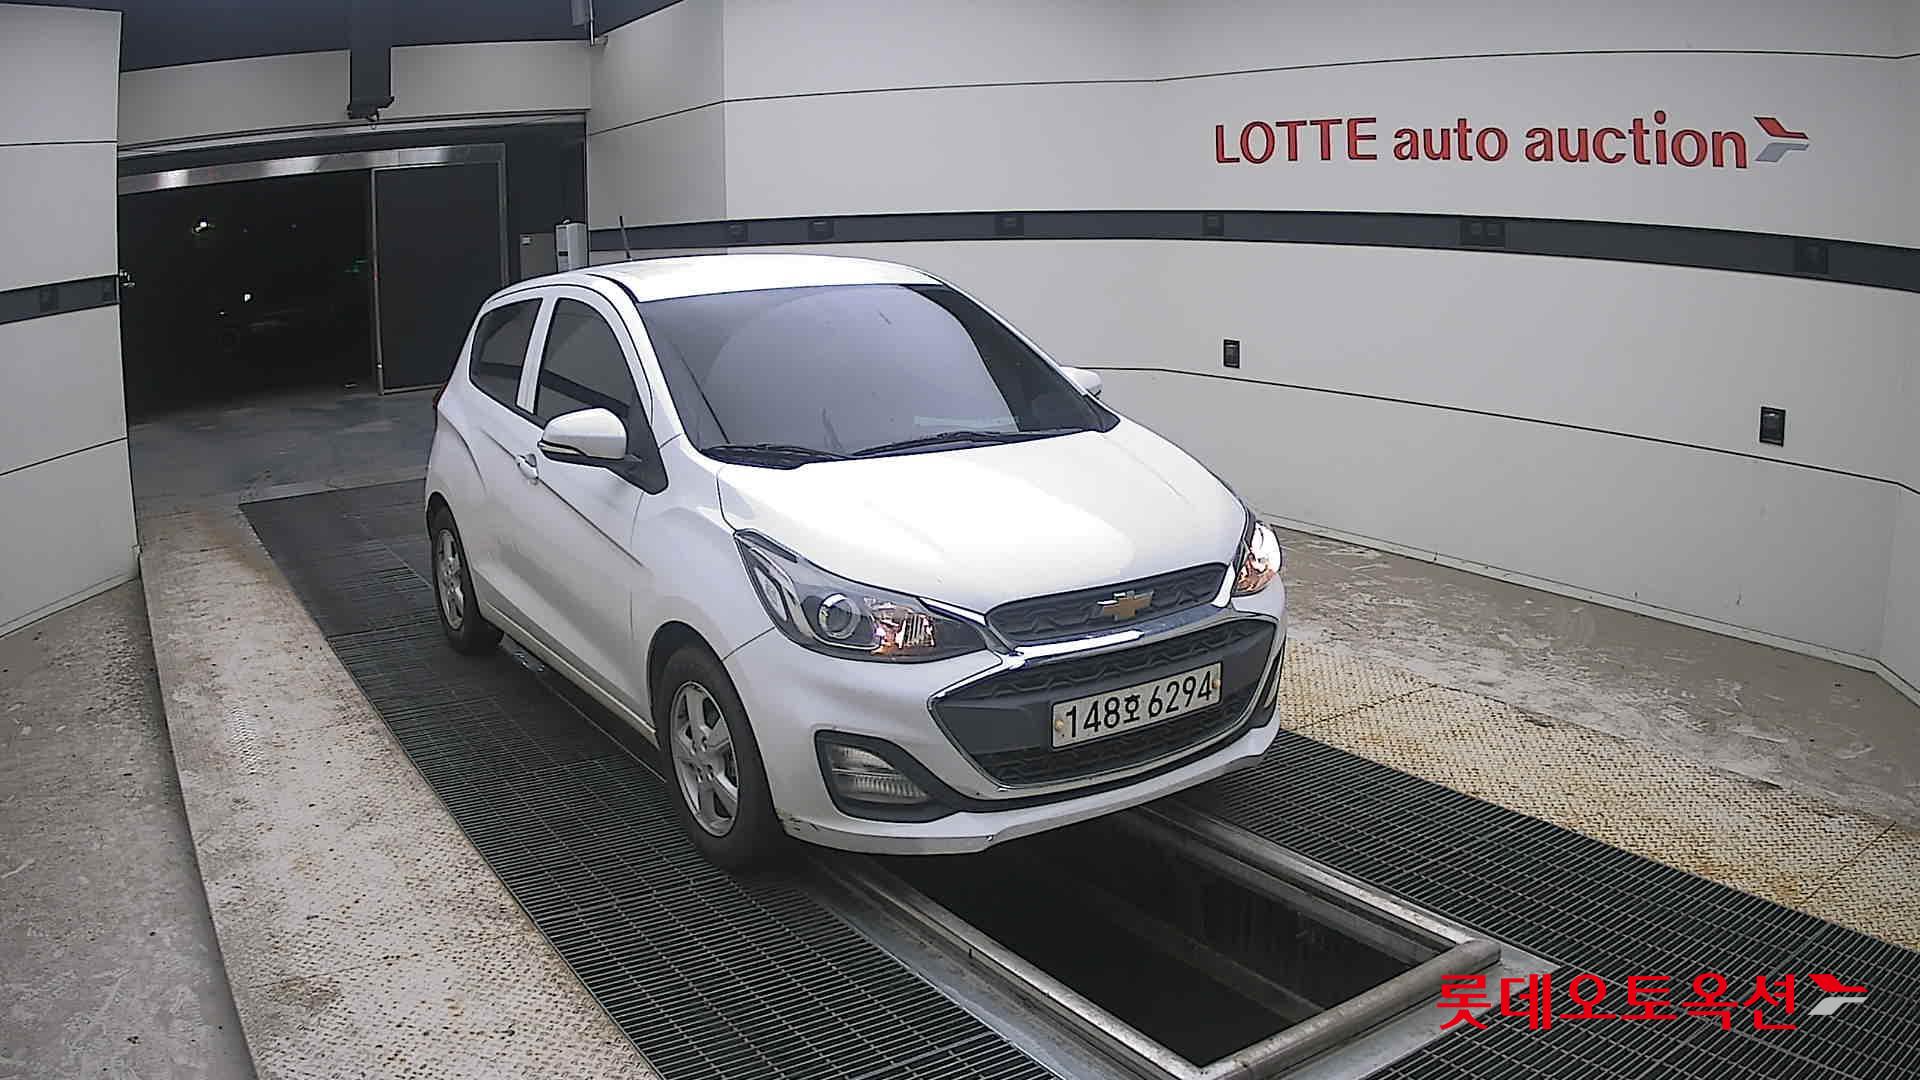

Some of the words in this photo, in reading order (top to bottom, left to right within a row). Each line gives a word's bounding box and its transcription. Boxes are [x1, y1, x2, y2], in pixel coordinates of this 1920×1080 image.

[1215, 117, 1377, 164] LOTTE
[1393, 118, 1508, 161] auto
[1525, 110, 1747, 168] auction
[1149, 671, 1212, 718] 6294
